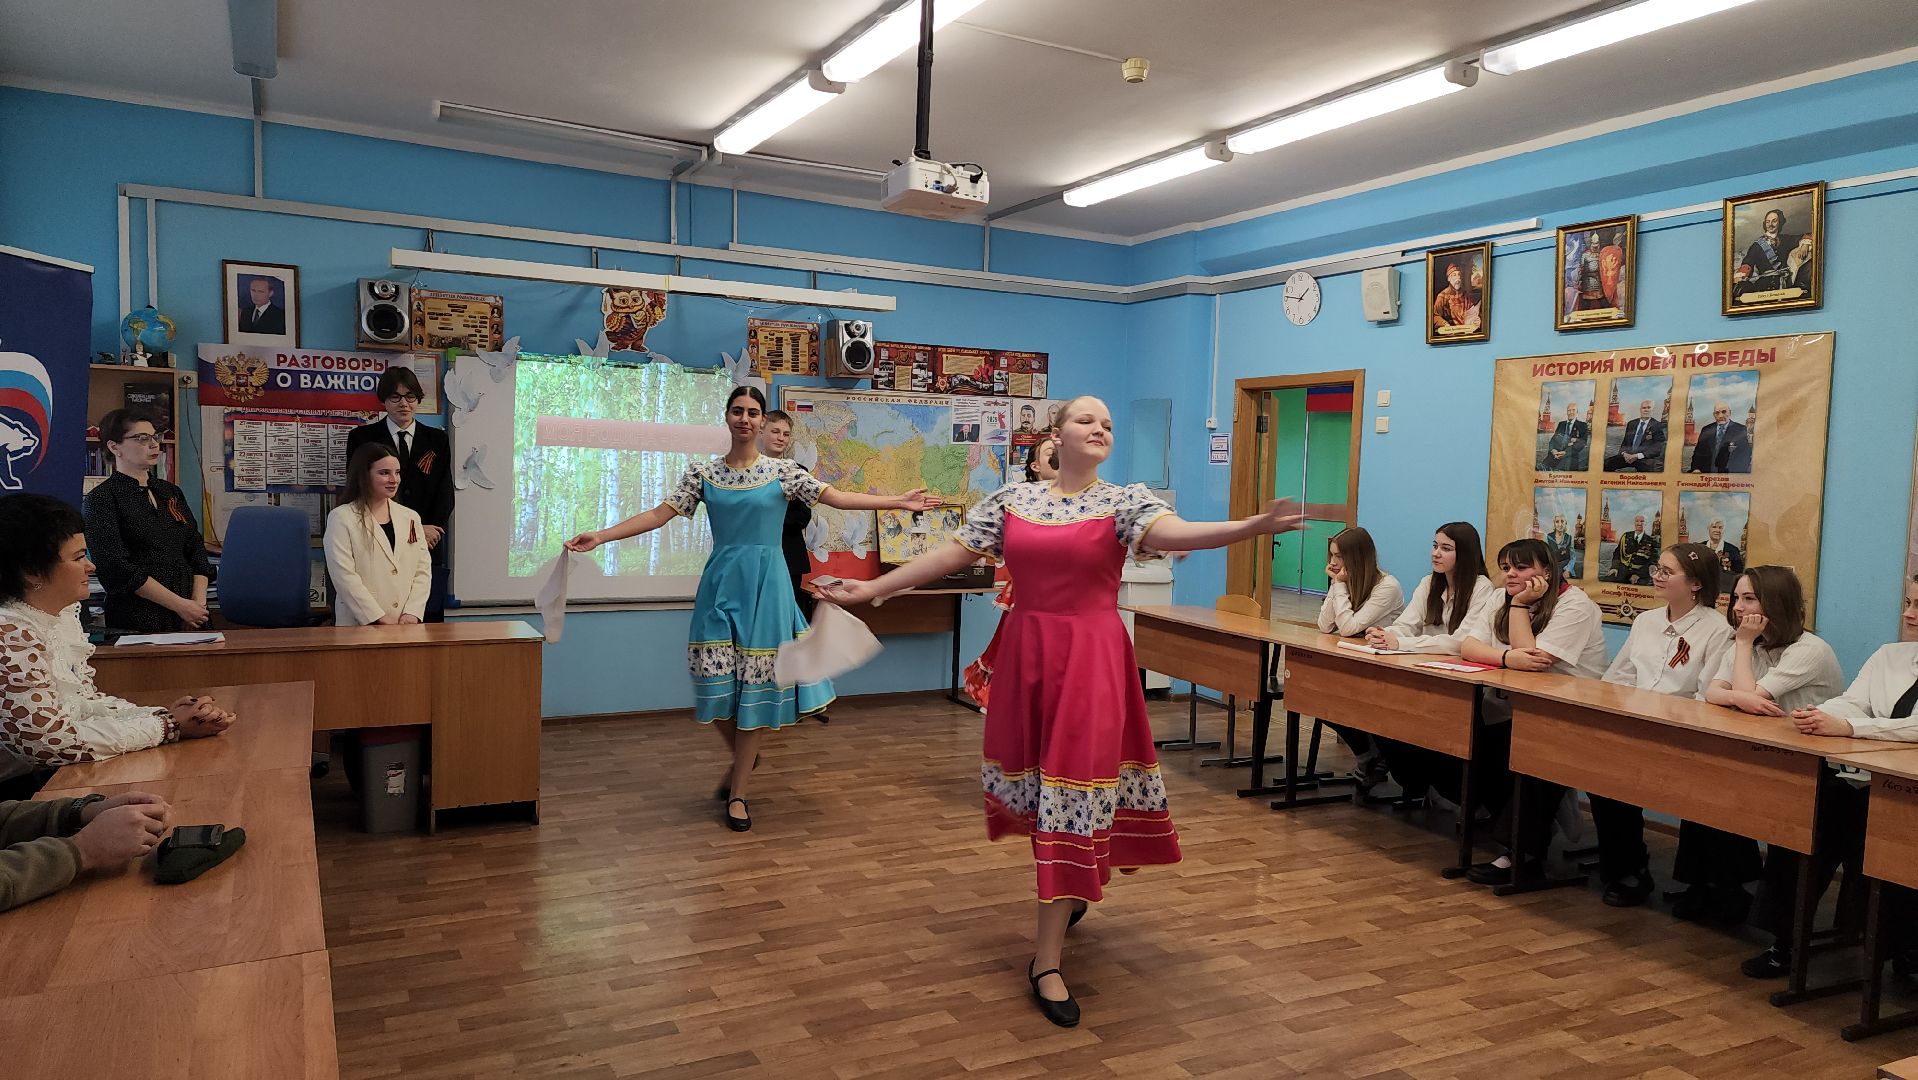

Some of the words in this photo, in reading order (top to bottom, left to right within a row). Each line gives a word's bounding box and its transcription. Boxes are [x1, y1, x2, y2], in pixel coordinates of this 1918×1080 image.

[276, 353, 389, 371] РАЗГОВОРЫ
[1531, 358, 1615, 378] ИСТОРИЯ
[1619, 351, 1677, 373] МОЕЙ
[1682, 347, 1777, 369] ПОБЕДЫ
[276, 372, 292, 388] О
[846, 396, 901, 404] РОССИЙСКАЯ
[1676, 480, 1711, 488] Геннадий
[1601, 589, 1622, 597] Иосиф
